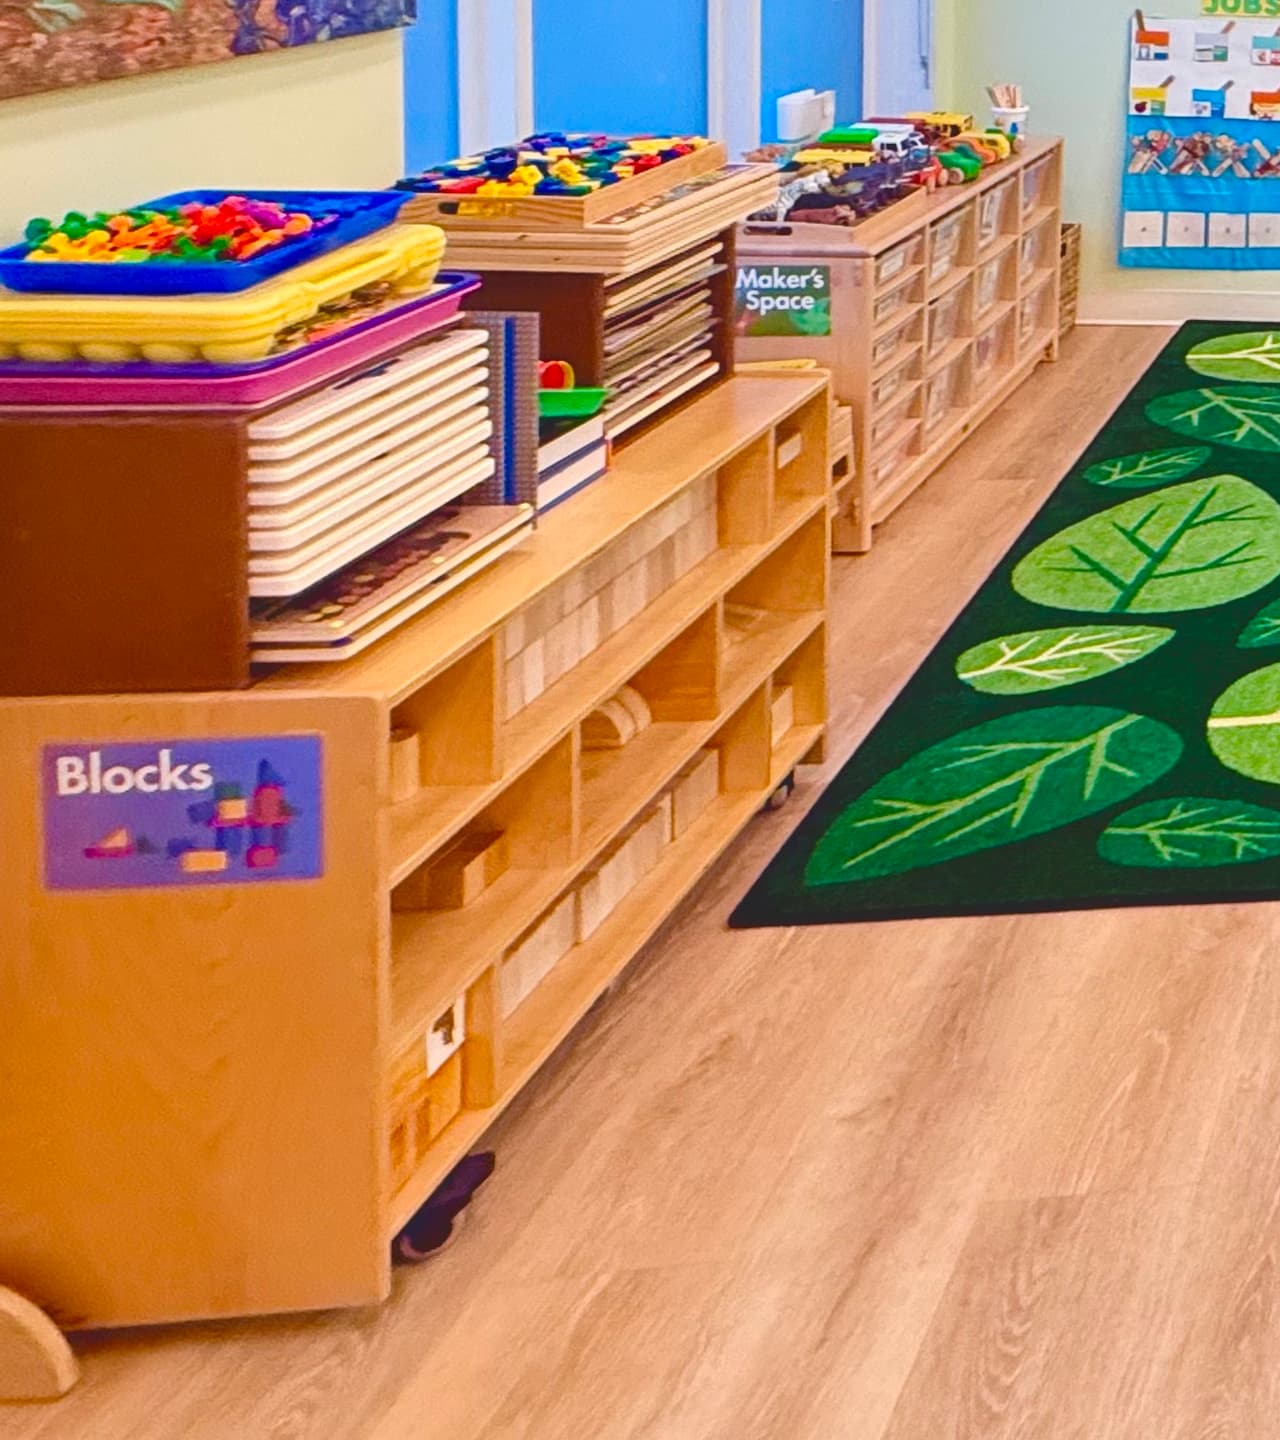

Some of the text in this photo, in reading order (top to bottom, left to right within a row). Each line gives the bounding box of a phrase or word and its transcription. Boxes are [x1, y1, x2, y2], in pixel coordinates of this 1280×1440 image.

[735, 267, 825, 288] Maker's
[746, 290, 815, 316] Space
[56, 749, 213, 795] Blocks
